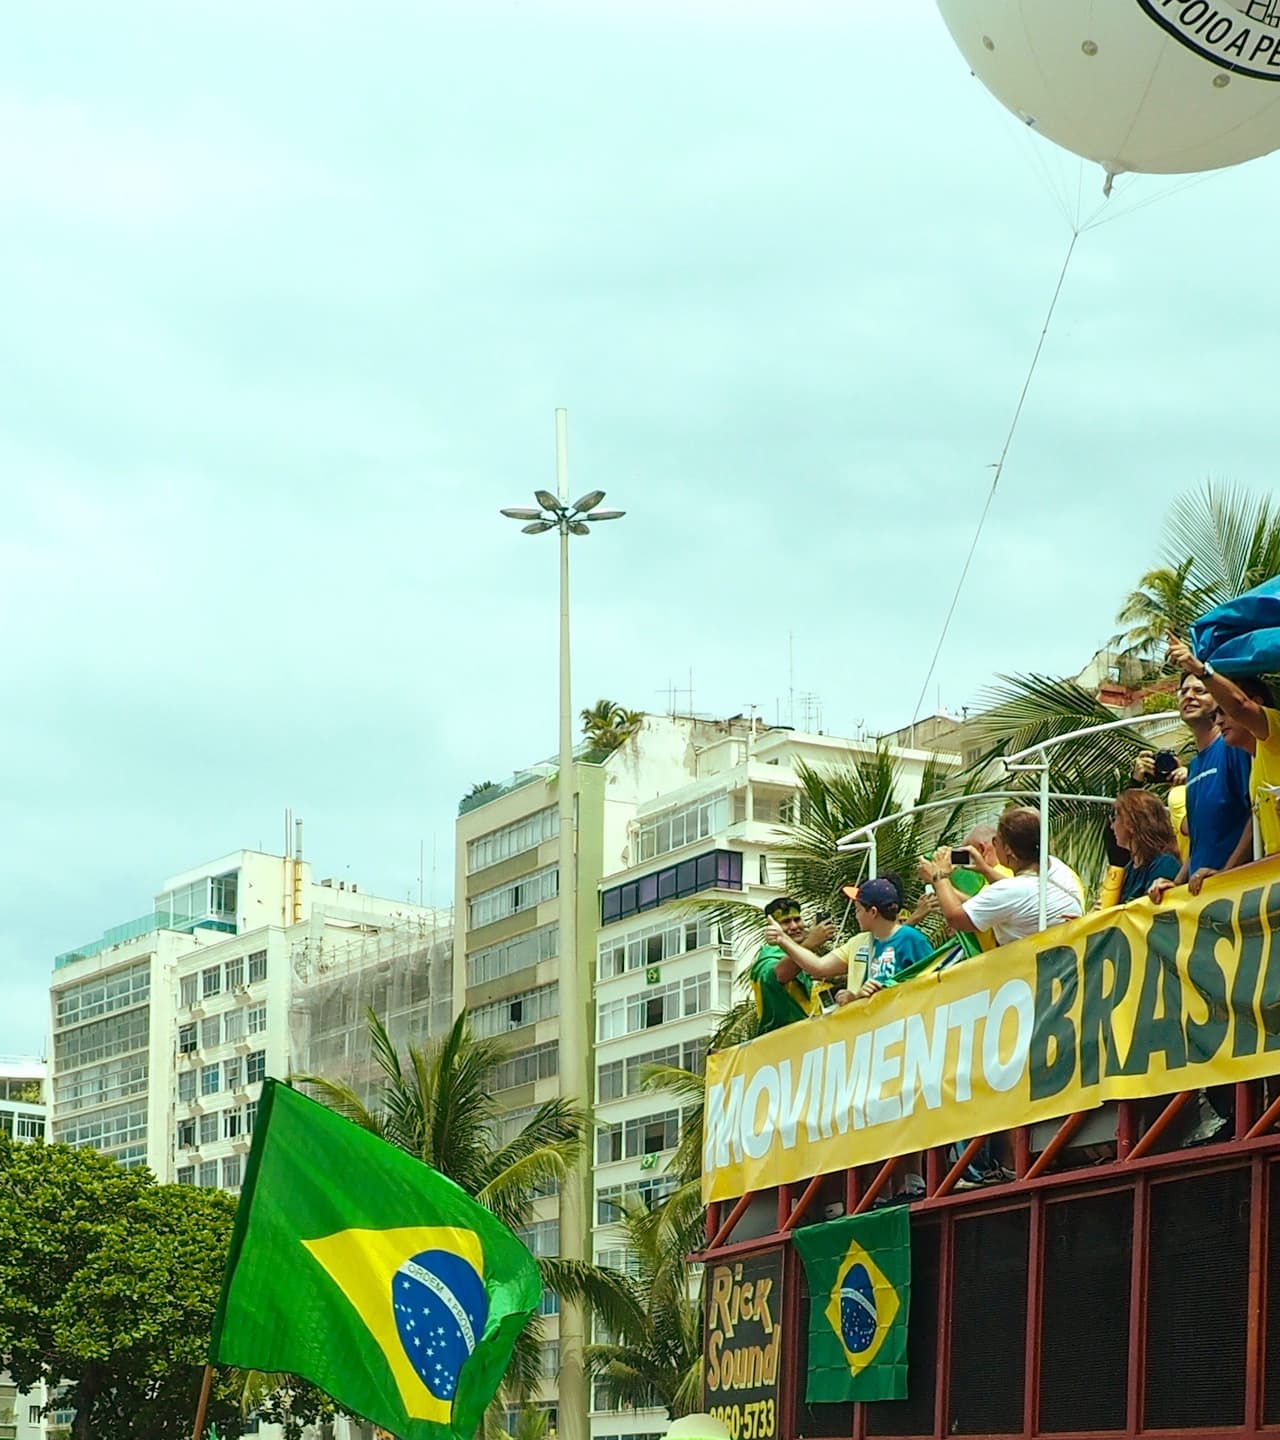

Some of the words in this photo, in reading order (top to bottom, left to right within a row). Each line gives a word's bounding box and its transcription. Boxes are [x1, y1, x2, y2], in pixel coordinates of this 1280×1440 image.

[1224, 28, 1251, 57] A
[706, 977, 1037, 1172] MOVIMENTO
[407, 1263, 445, 1294] ORDEM
[707, 1324, 781, 1391] Sound
